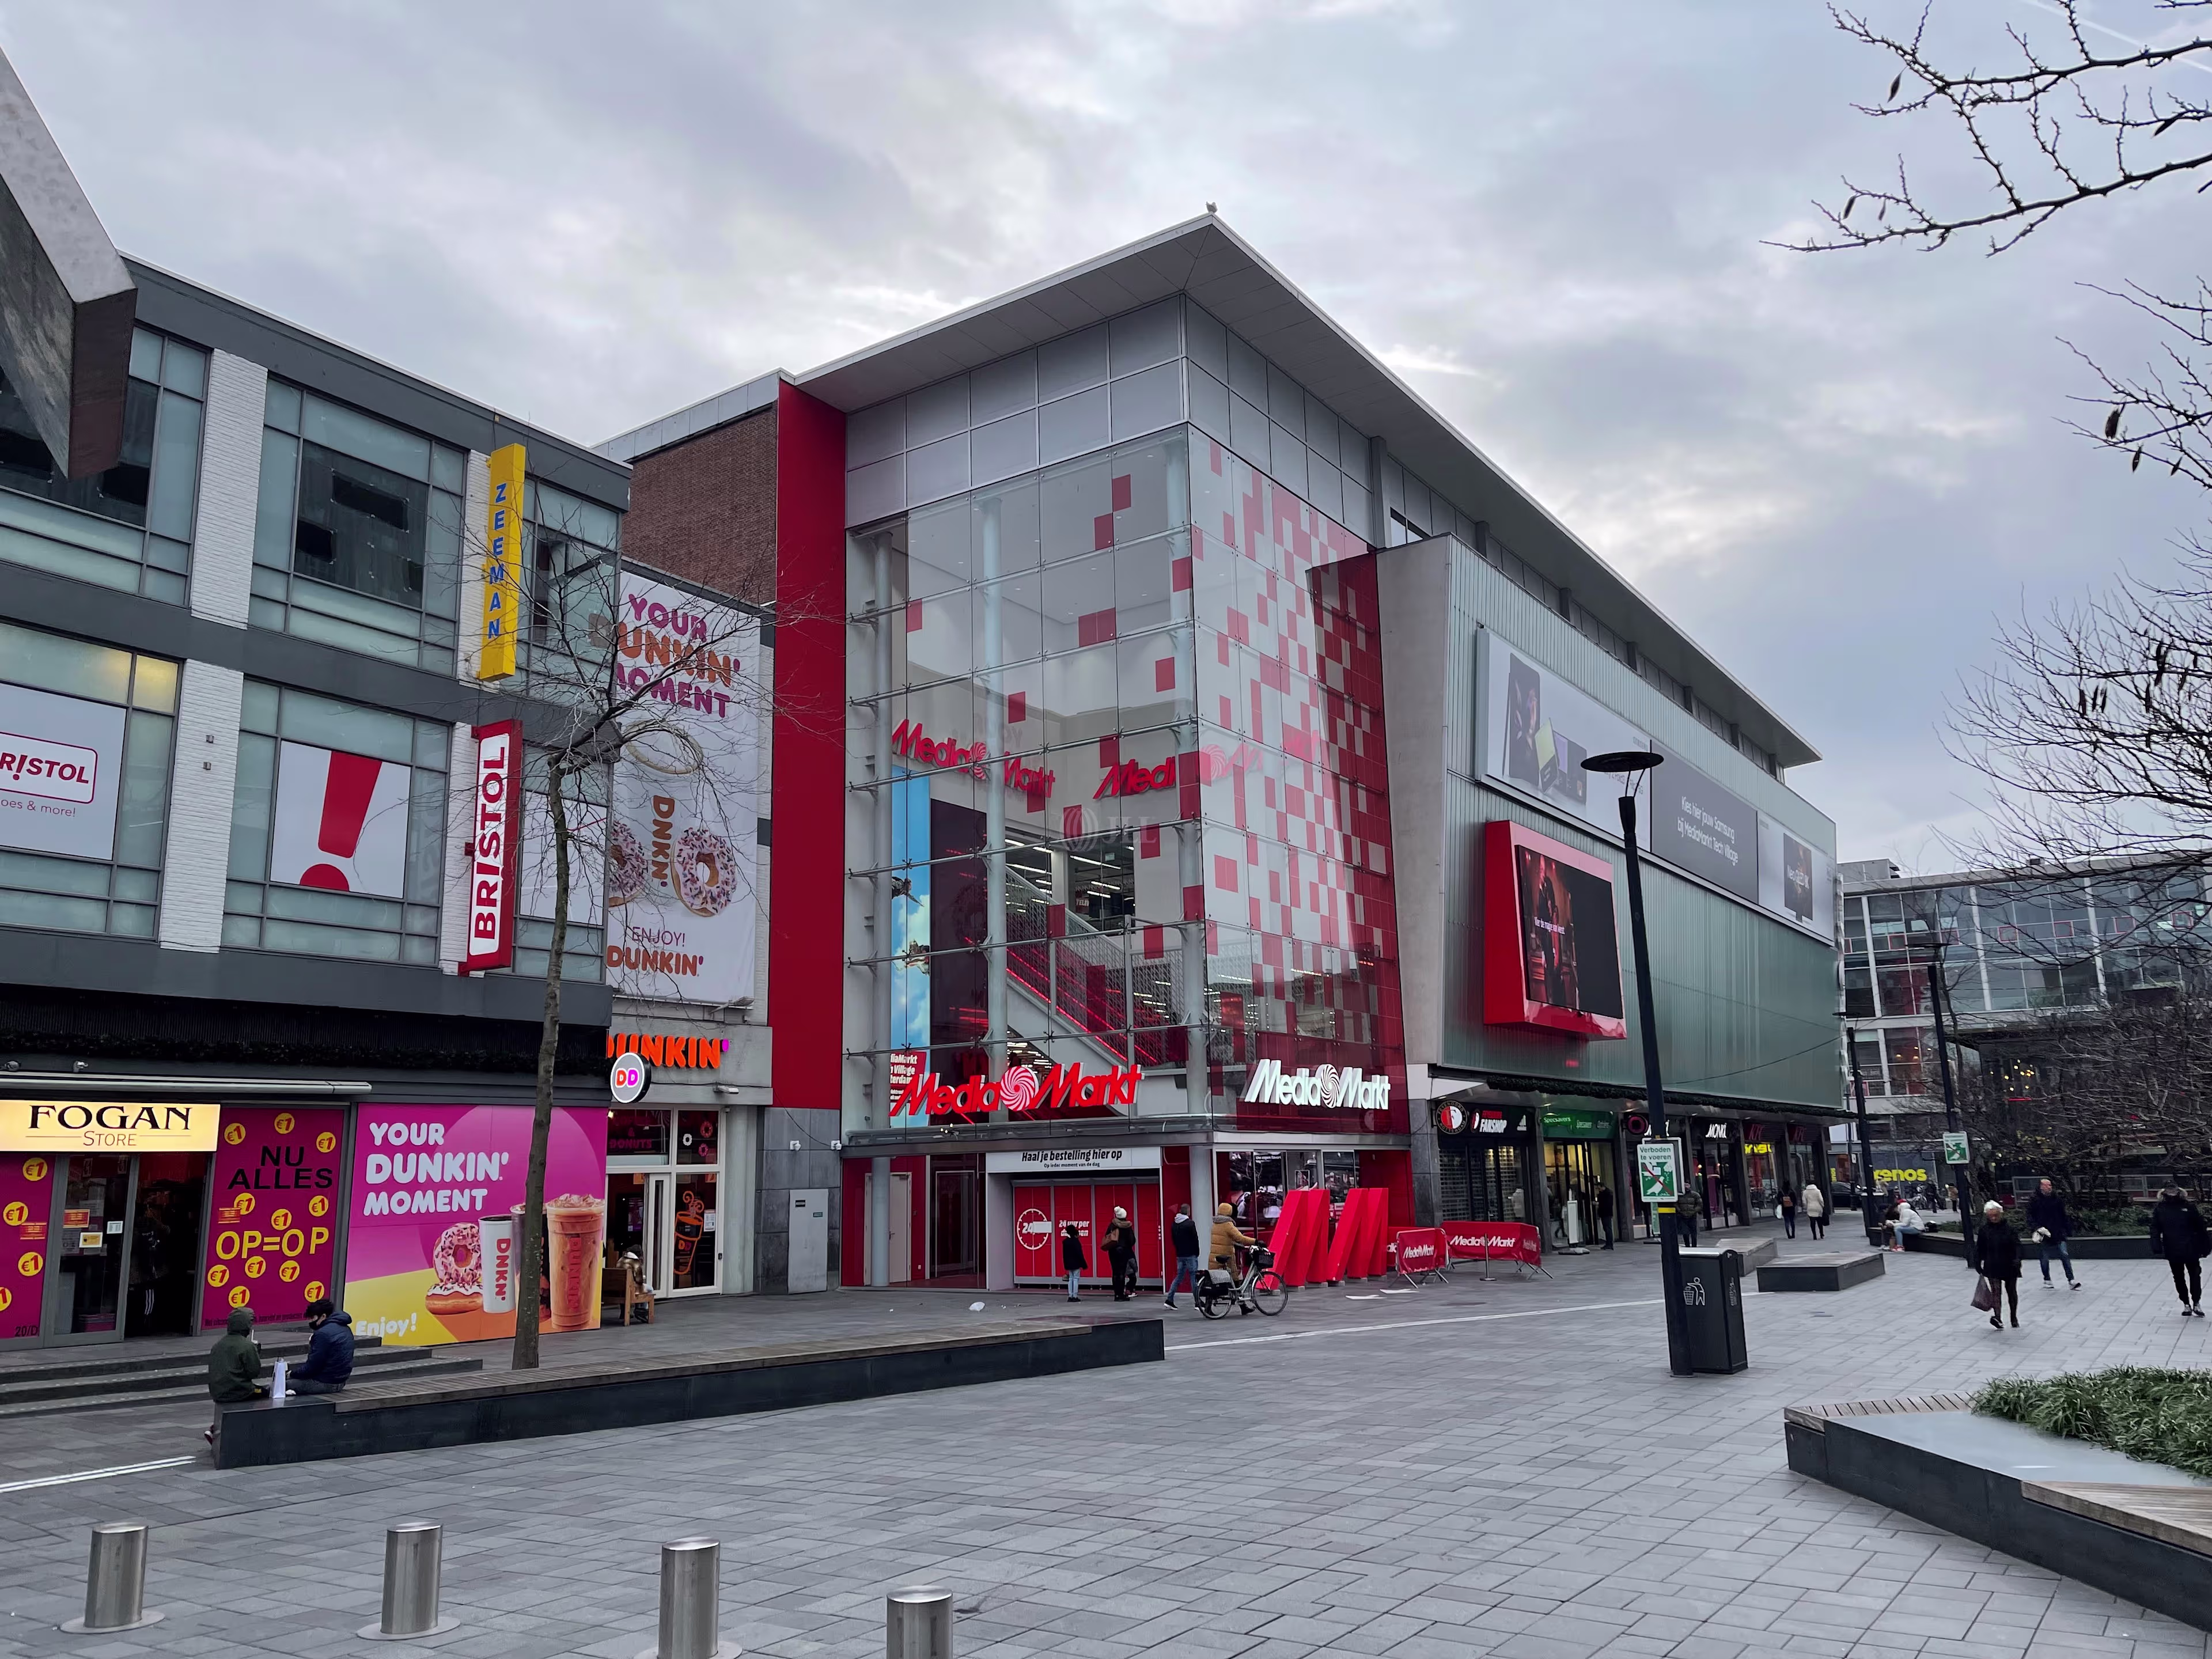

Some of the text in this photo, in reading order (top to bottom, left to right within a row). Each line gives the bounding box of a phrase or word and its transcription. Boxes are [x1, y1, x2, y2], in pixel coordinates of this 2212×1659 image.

[488, 482, 507, 640] ZEEMAN
[628, 594, 707, 643] YOUR
[1093, 756, 1176, 799] Medi
[1, 799, 76, 817] oes & more!
[607, 945, 703, 976] DUNKIN'
[615, 1068, 639, 1088] DD
[28, 1105, 192, 1130] FOGAN
[1479, 1119, 1508, 1133] FANSHOP
[83, 1131, 137, 1147] STORE
[369, 1122, 444, 1146] YOUR
[260, 1146, 305, 1166] NU
[1022, 1148, 1122, 1162] Haal je bestelling hier op
[227, 1168, 333, 1190] ALLES
[365, 1152, 509, 1184] DUNKIN'
[363, 1189, 488, 1217] MOMENT
[1078, 1221, 1090, 1229] per
[495, 1238, 511, 1301] DNKN'
[0, 1288, 7, 1304] 1
